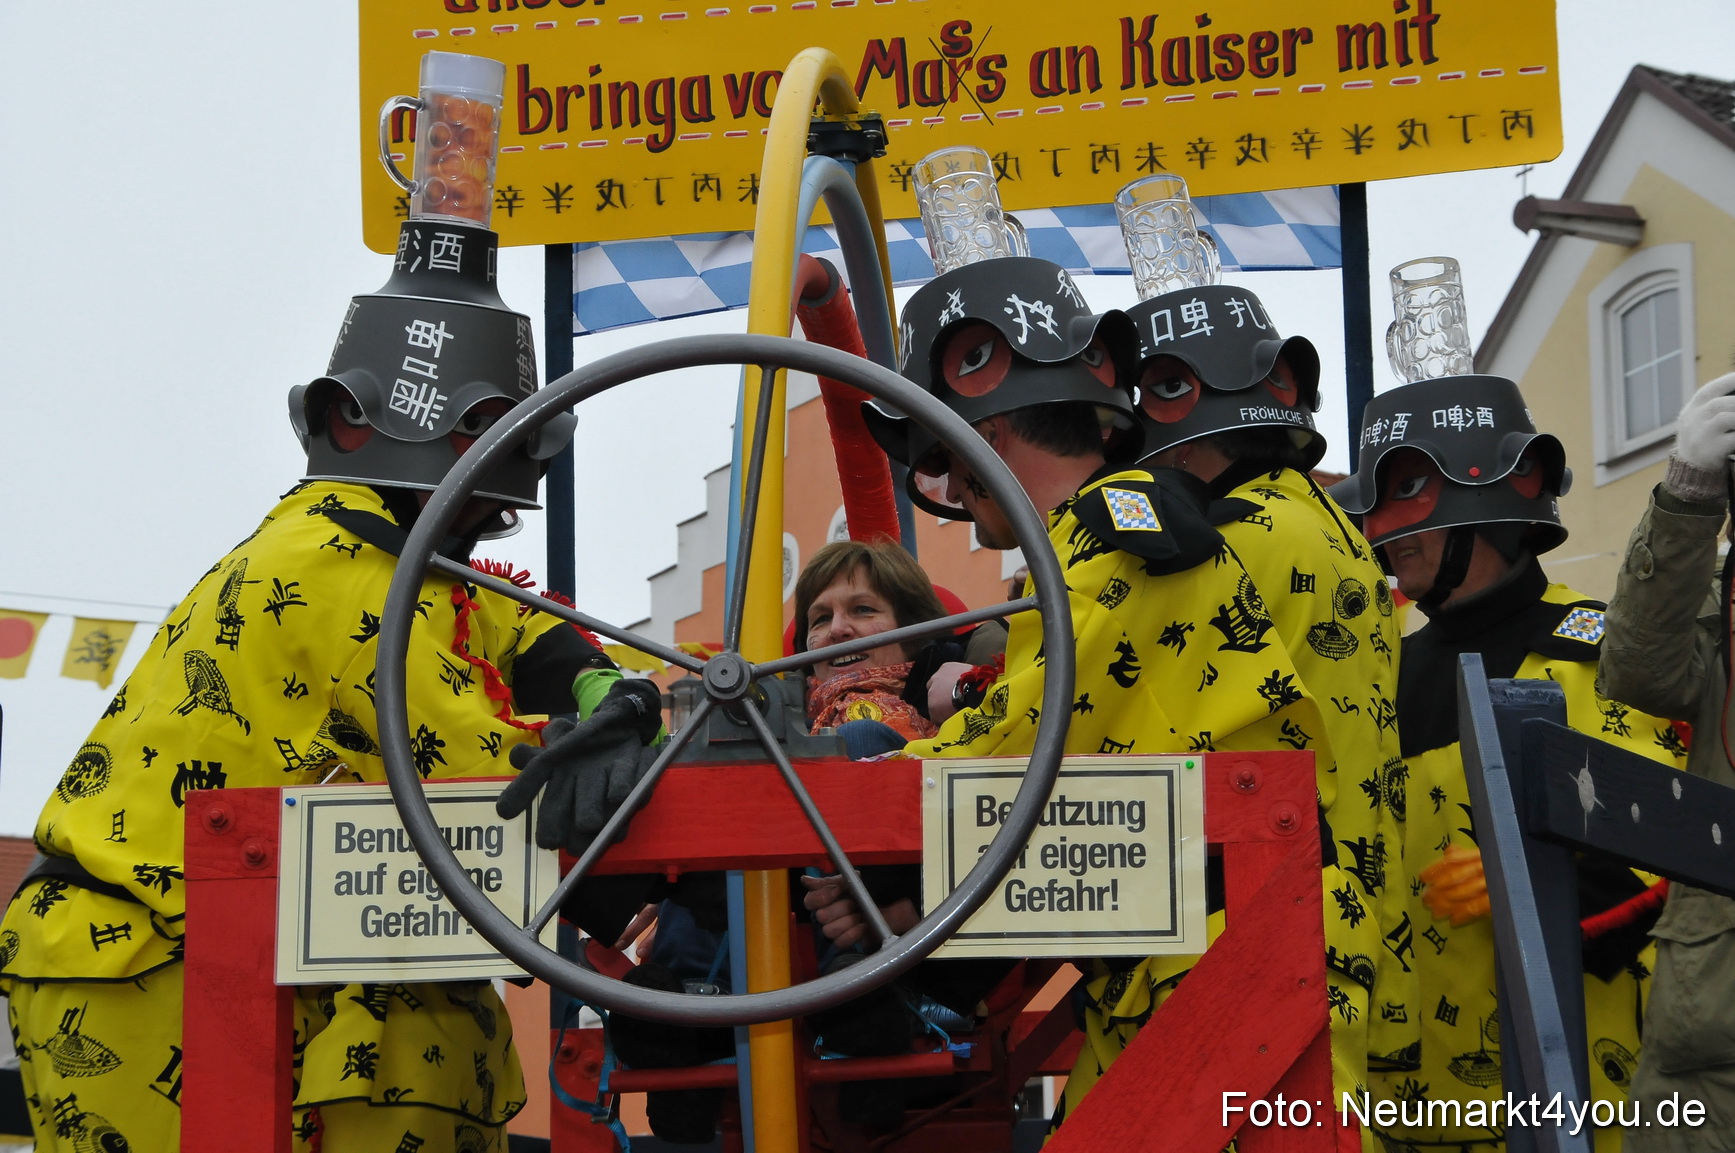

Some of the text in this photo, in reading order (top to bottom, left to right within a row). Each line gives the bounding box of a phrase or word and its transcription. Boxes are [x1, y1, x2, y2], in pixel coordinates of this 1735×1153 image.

[516, 63, 716, 153] bringa
[721, 69, 784, 119] vo
[1029, 44, 1102, 97] an
[1119, 13, 1313, 90] Kaiser
[1336, 0, 1442, 74] mit
[1239, 405, 1304, 425] FRÖHLICHE
[975, 794, 1146, 833] Beutzung
[334, 821, 504, 858] Benuung
[1040, 835, 1147, 876] eigene
[334, 862, 503, 901] auf eigne
[1004, 878, 1119, 913] Gefahr!
